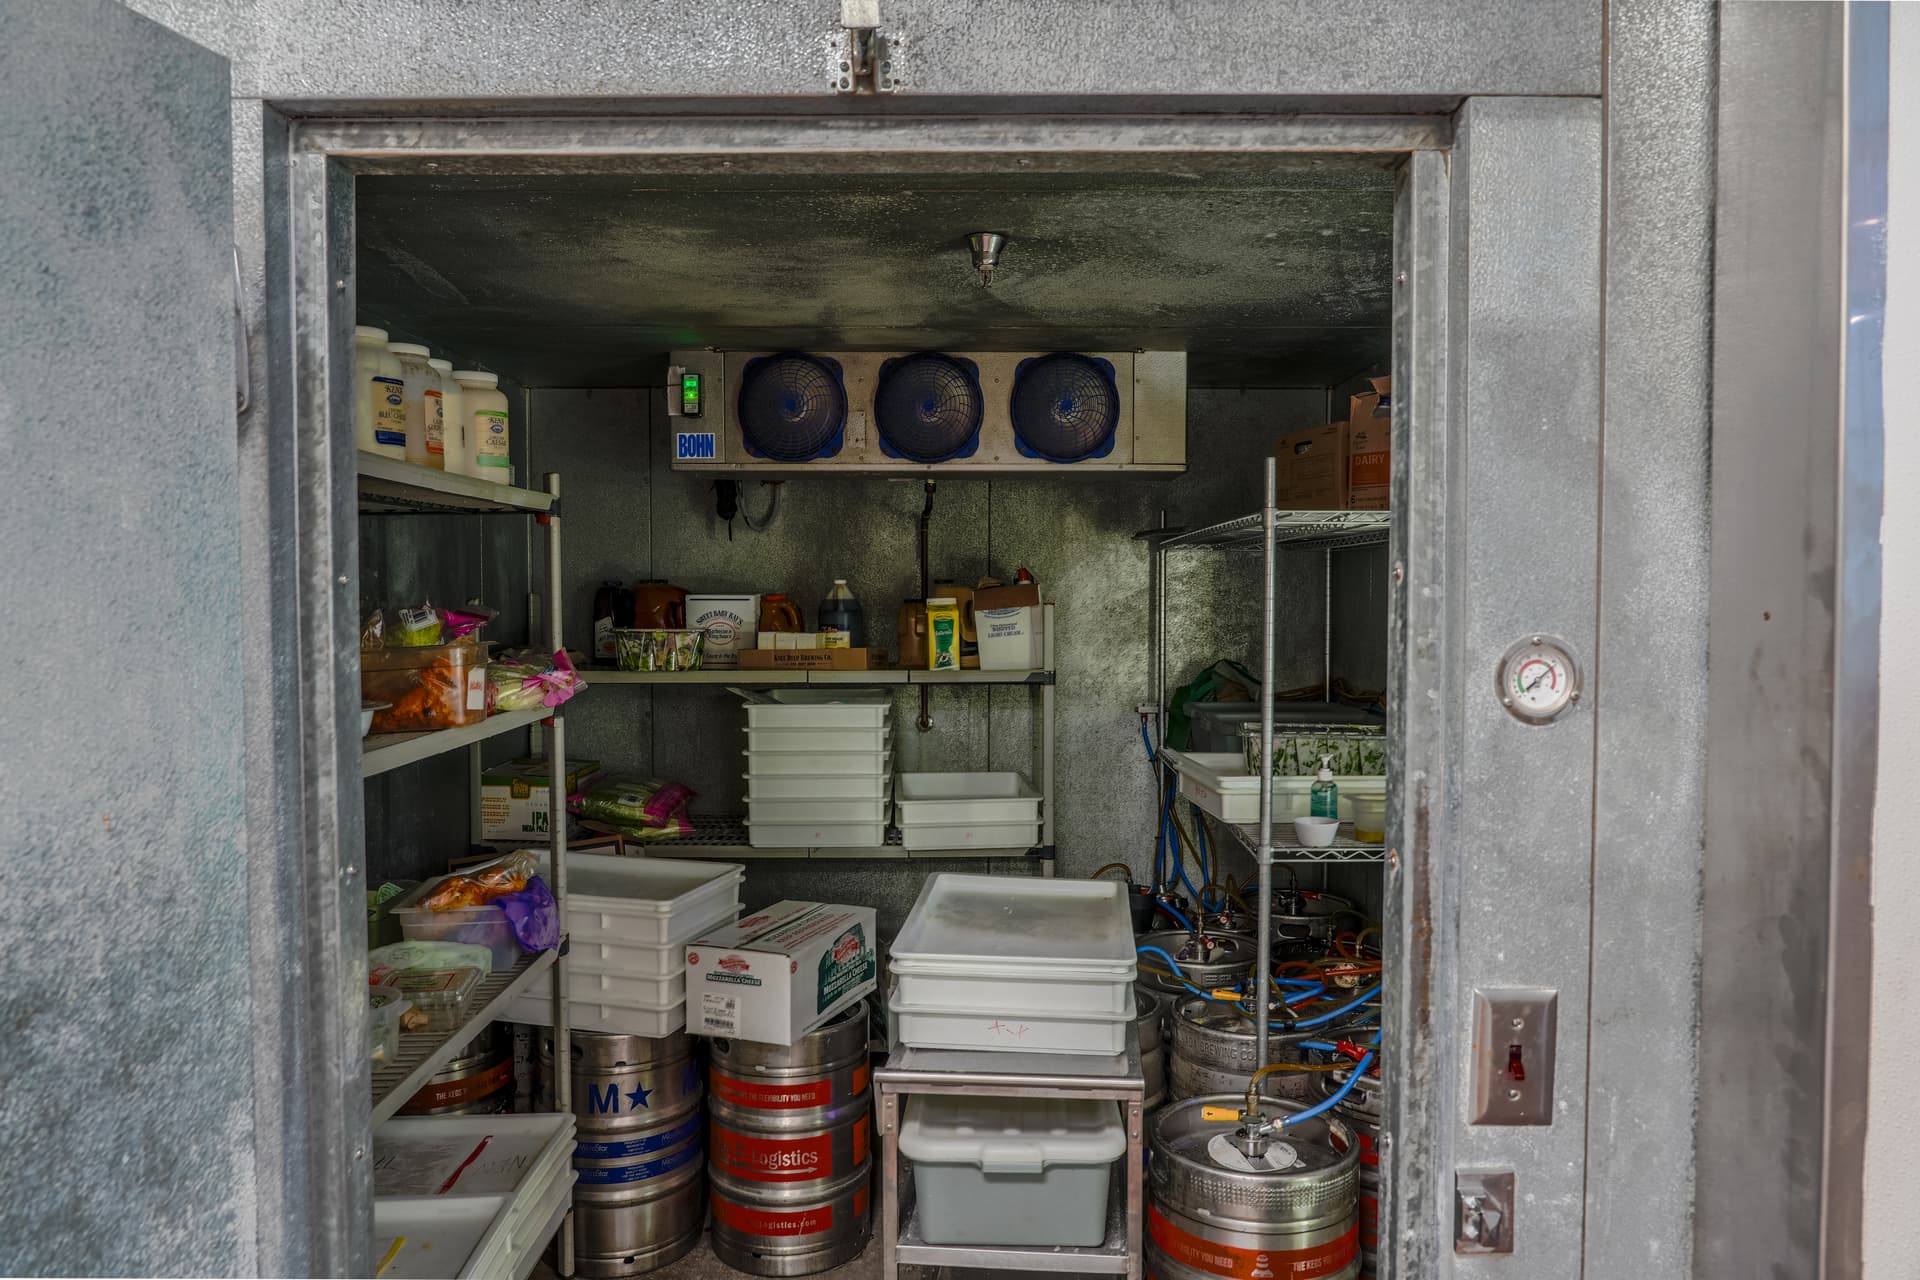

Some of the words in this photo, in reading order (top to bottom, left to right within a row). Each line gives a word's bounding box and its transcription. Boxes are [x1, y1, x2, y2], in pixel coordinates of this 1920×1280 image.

[678, 434, 714, 458] BOHN
[1355, 454, 1385, 466] DAIRY
[532, 811, 549, 826] IPA
[1200, 1040, 1238, 1060] BREWING
[435, 1092, 448, 1101] THE
[589, 1083, 619, 1114] M
[1201, 1252, 1214, 1264] YOU
[1293, 1260, 1307, 1272] THE
